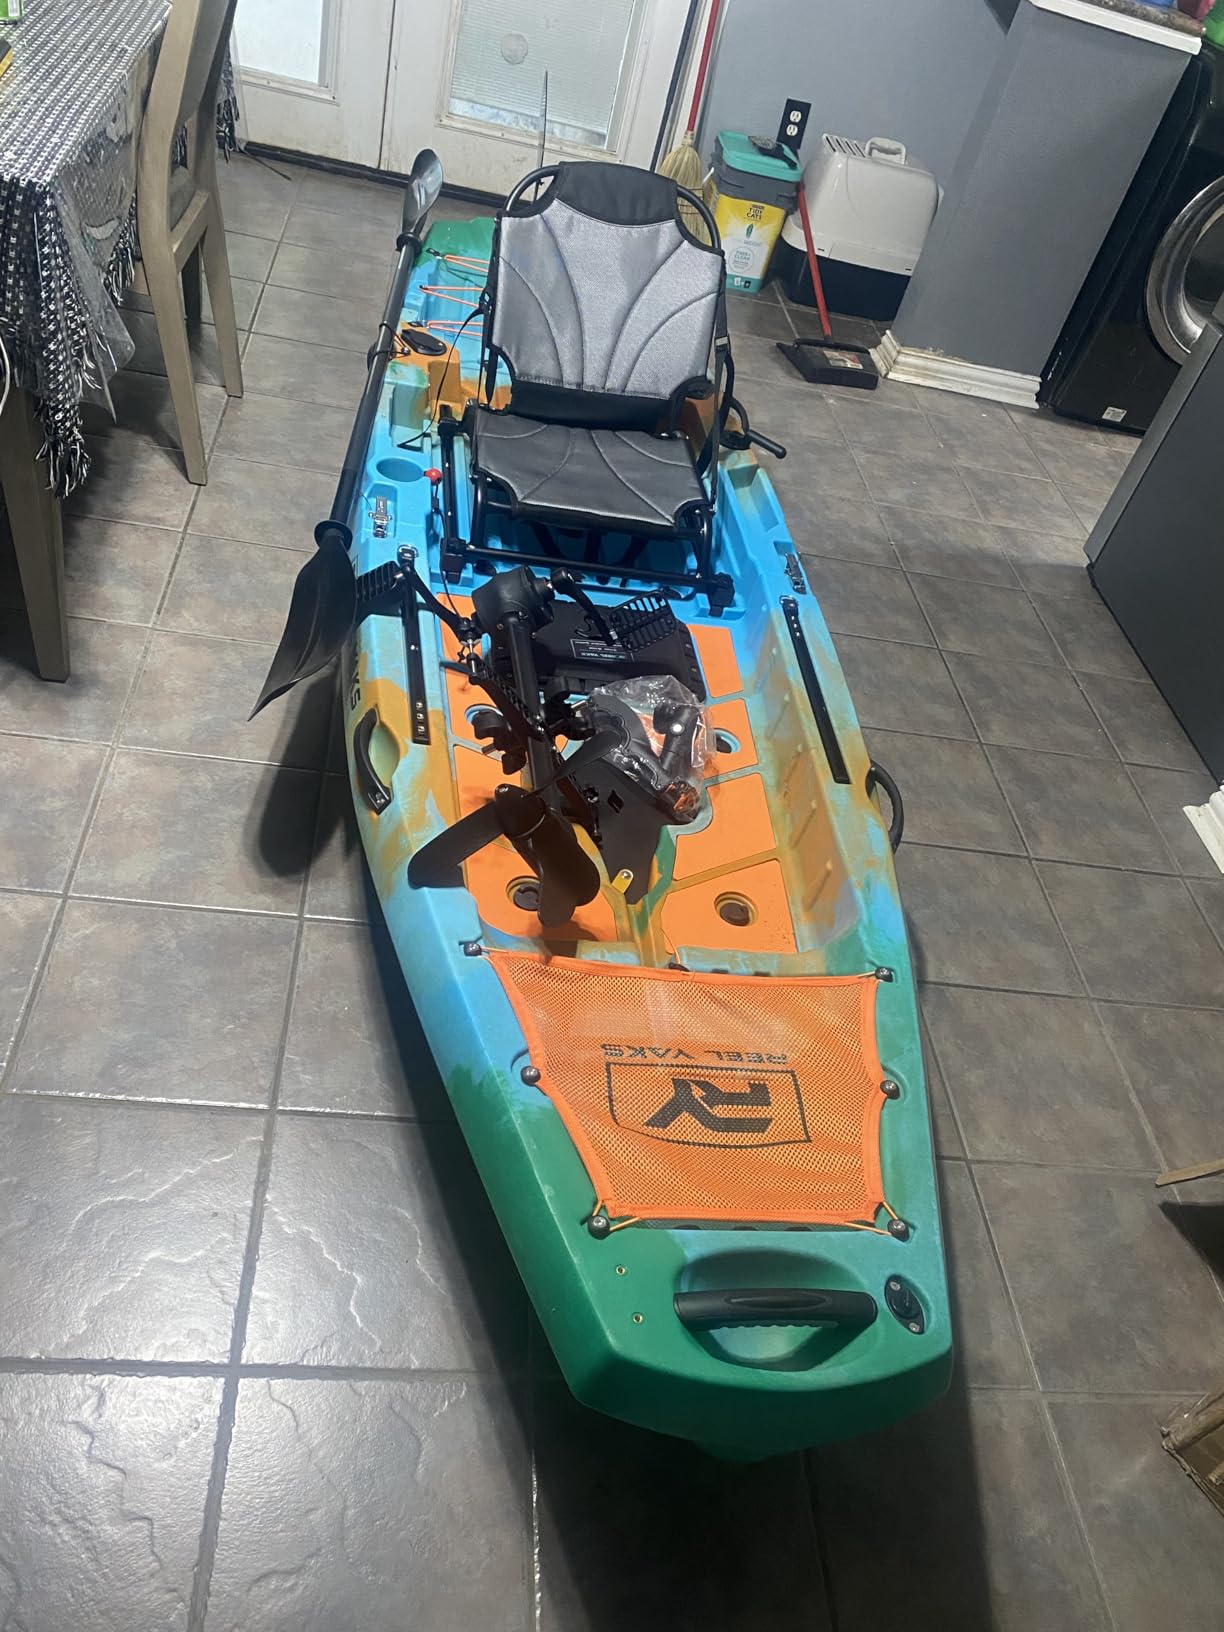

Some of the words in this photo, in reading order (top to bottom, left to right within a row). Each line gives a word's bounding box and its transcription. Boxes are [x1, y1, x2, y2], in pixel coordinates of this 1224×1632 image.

[746, 212, 762, 220] CATS
[600, 1043, 695, 1060] YAKS
[703, 1049, 788, 1065] REEL
